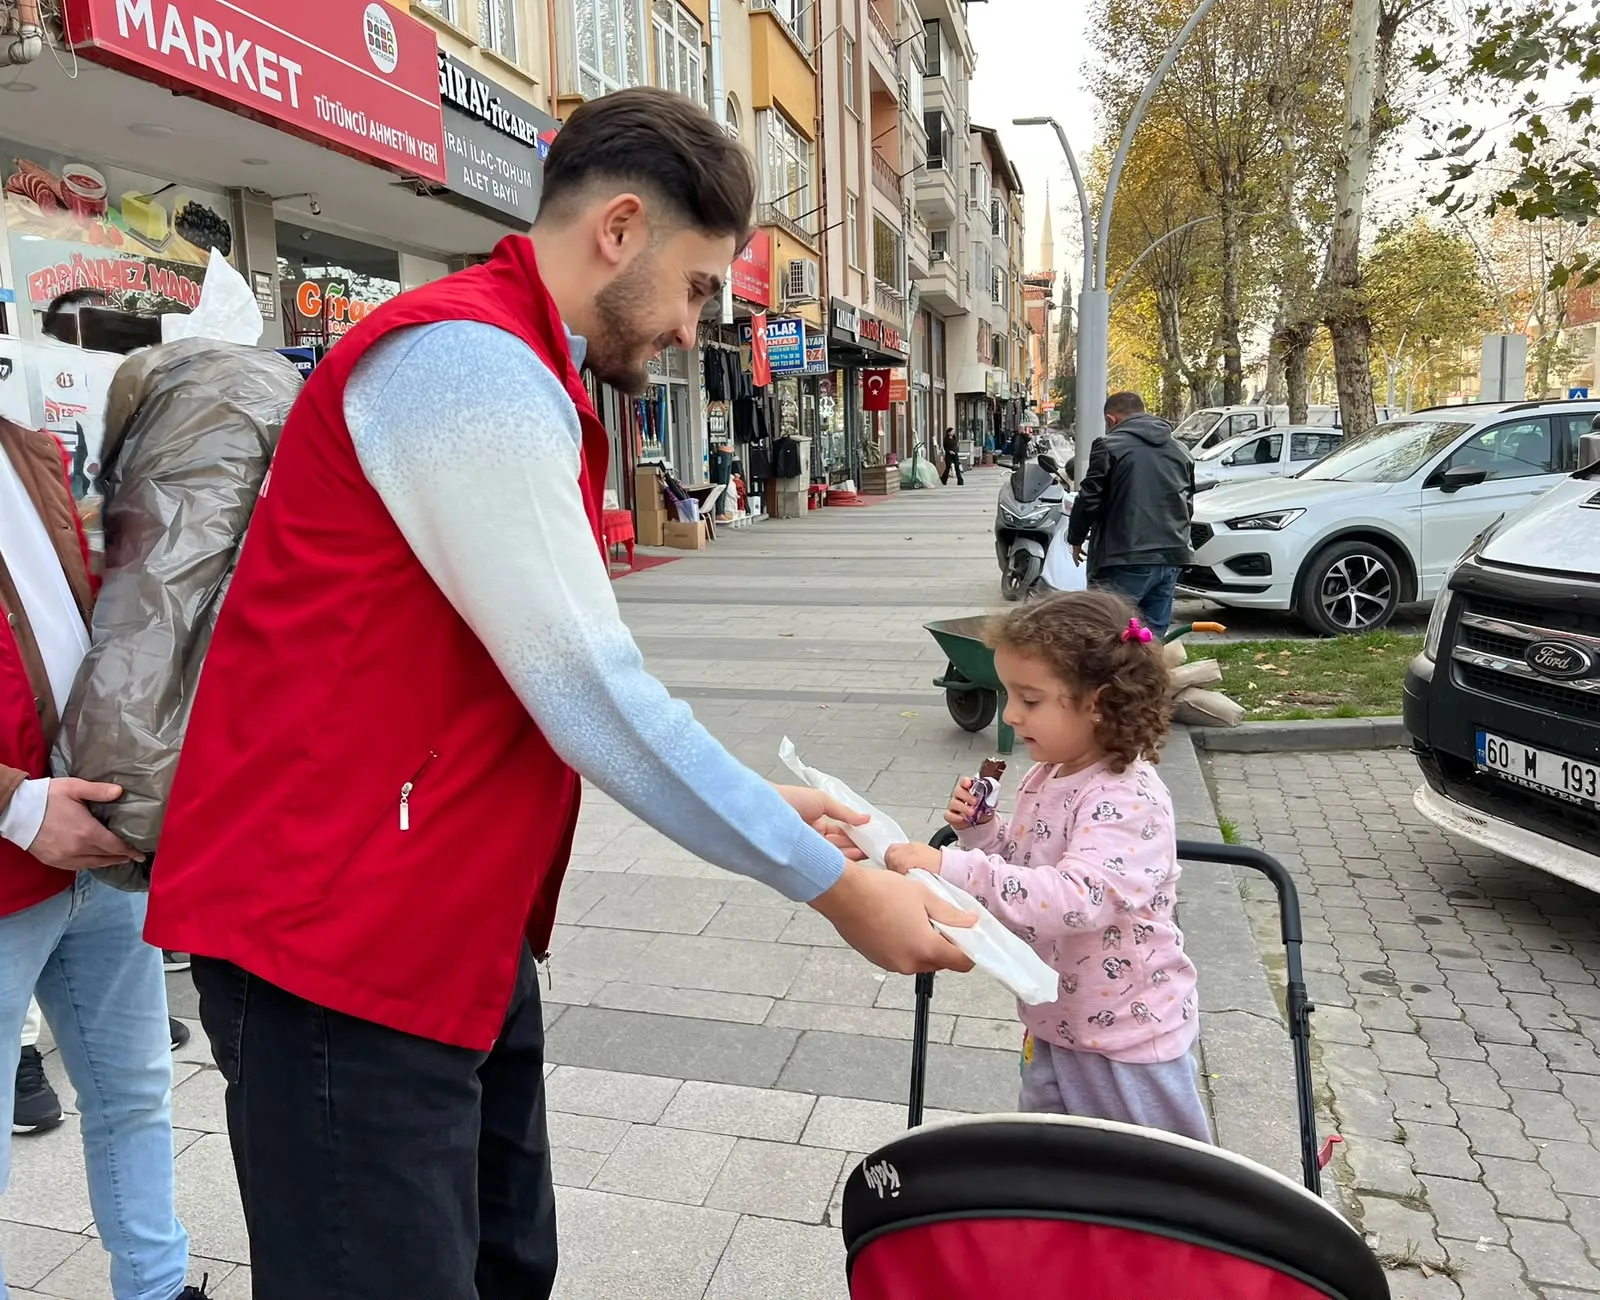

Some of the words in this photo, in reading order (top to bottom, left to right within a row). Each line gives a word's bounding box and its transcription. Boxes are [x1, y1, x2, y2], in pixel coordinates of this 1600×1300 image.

[115, 0, 302, 109] MARKET
[313, 94, 367, 137] TÜTÜNCÜ
[416, 139, 438, 165] YERİ
[490, 97, 539, 149] TİCARET
[463, 166, 489, 193] ALET
[743, 321, 797, 339] DTLAR
[1534, 646, 1573, 669] Ford
[1487, 738, 1510, 769] 60
[1524, 748, 1537, 779] M
